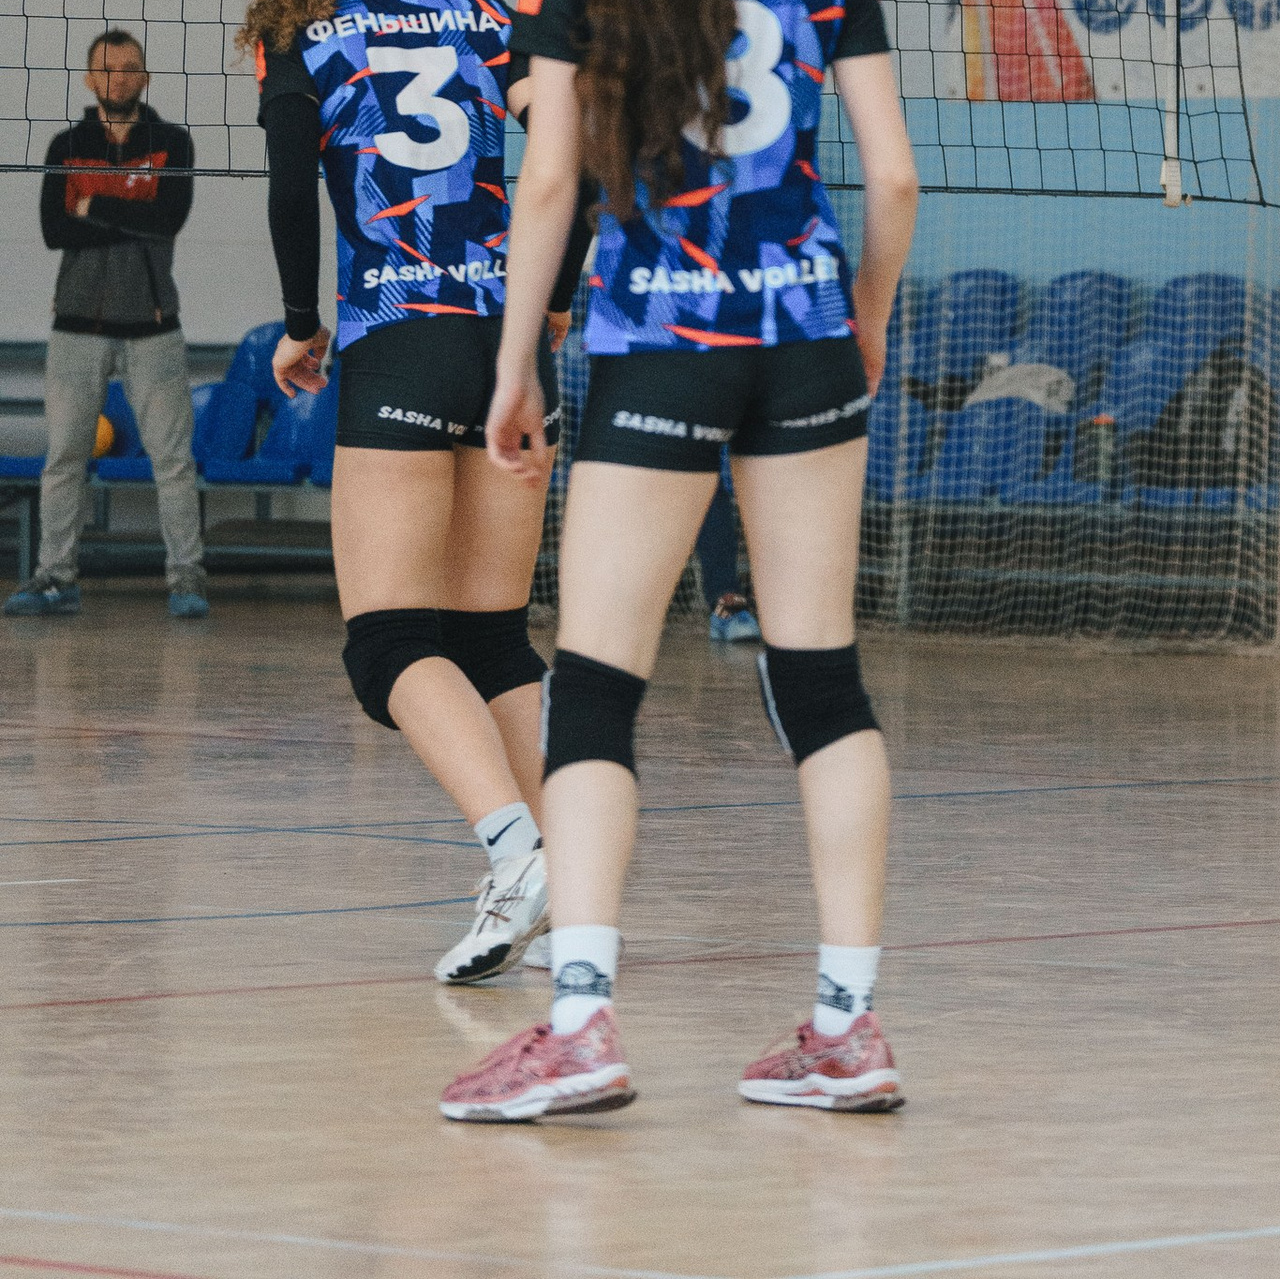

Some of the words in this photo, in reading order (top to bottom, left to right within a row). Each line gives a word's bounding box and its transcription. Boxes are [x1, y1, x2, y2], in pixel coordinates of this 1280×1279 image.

[306, 10, 501, 42] ФЕНЬШИНА
[365, 45, 470, 171] 3
[447, 259, 507, 283] VOLL
[629, 266, 735, 295] SASHA
[378, 405, 442, 430] SASHA
